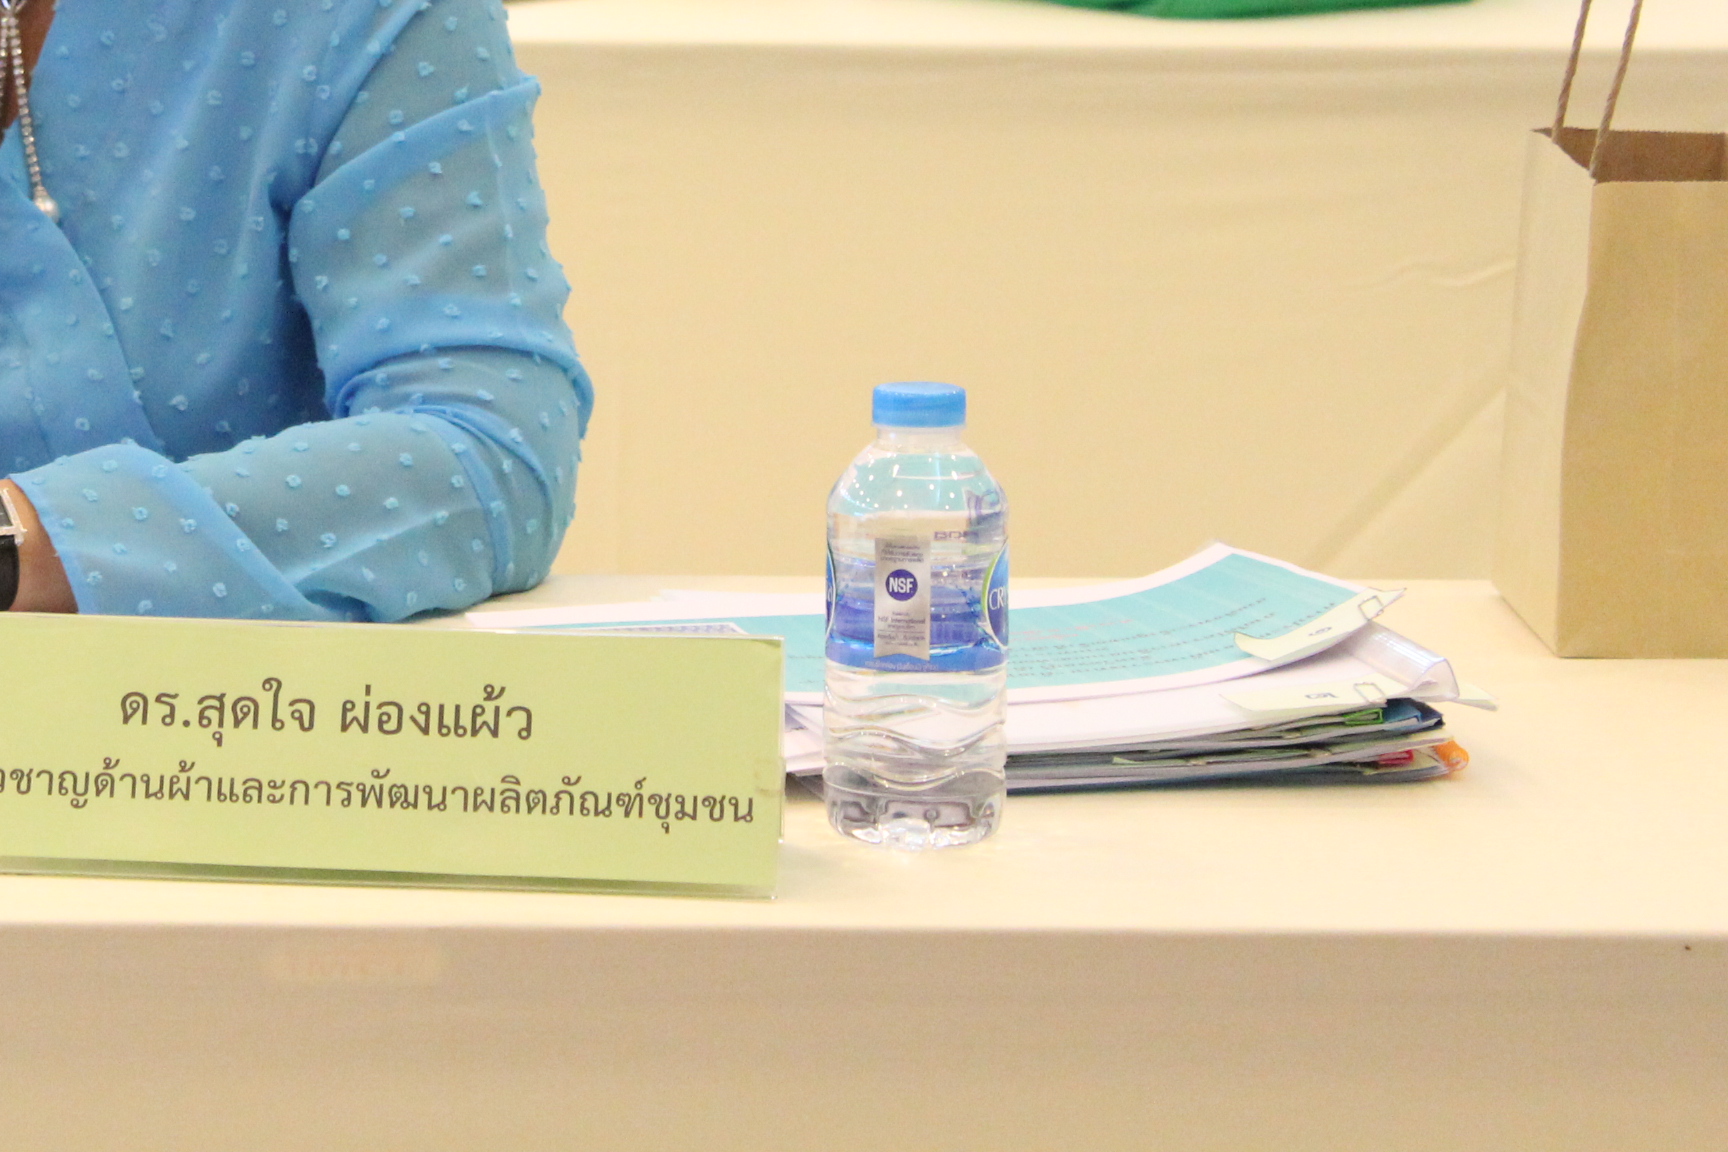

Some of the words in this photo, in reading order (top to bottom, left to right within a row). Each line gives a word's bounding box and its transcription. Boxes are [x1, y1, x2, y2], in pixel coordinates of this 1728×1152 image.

[888, 577, 914, 594] NSF
[989, 586, 1007, 611] CR
[120, 677, 316, 748] ดร.สุดใจ
[340, 683, 533, 741] ผ่องแผ้ว
